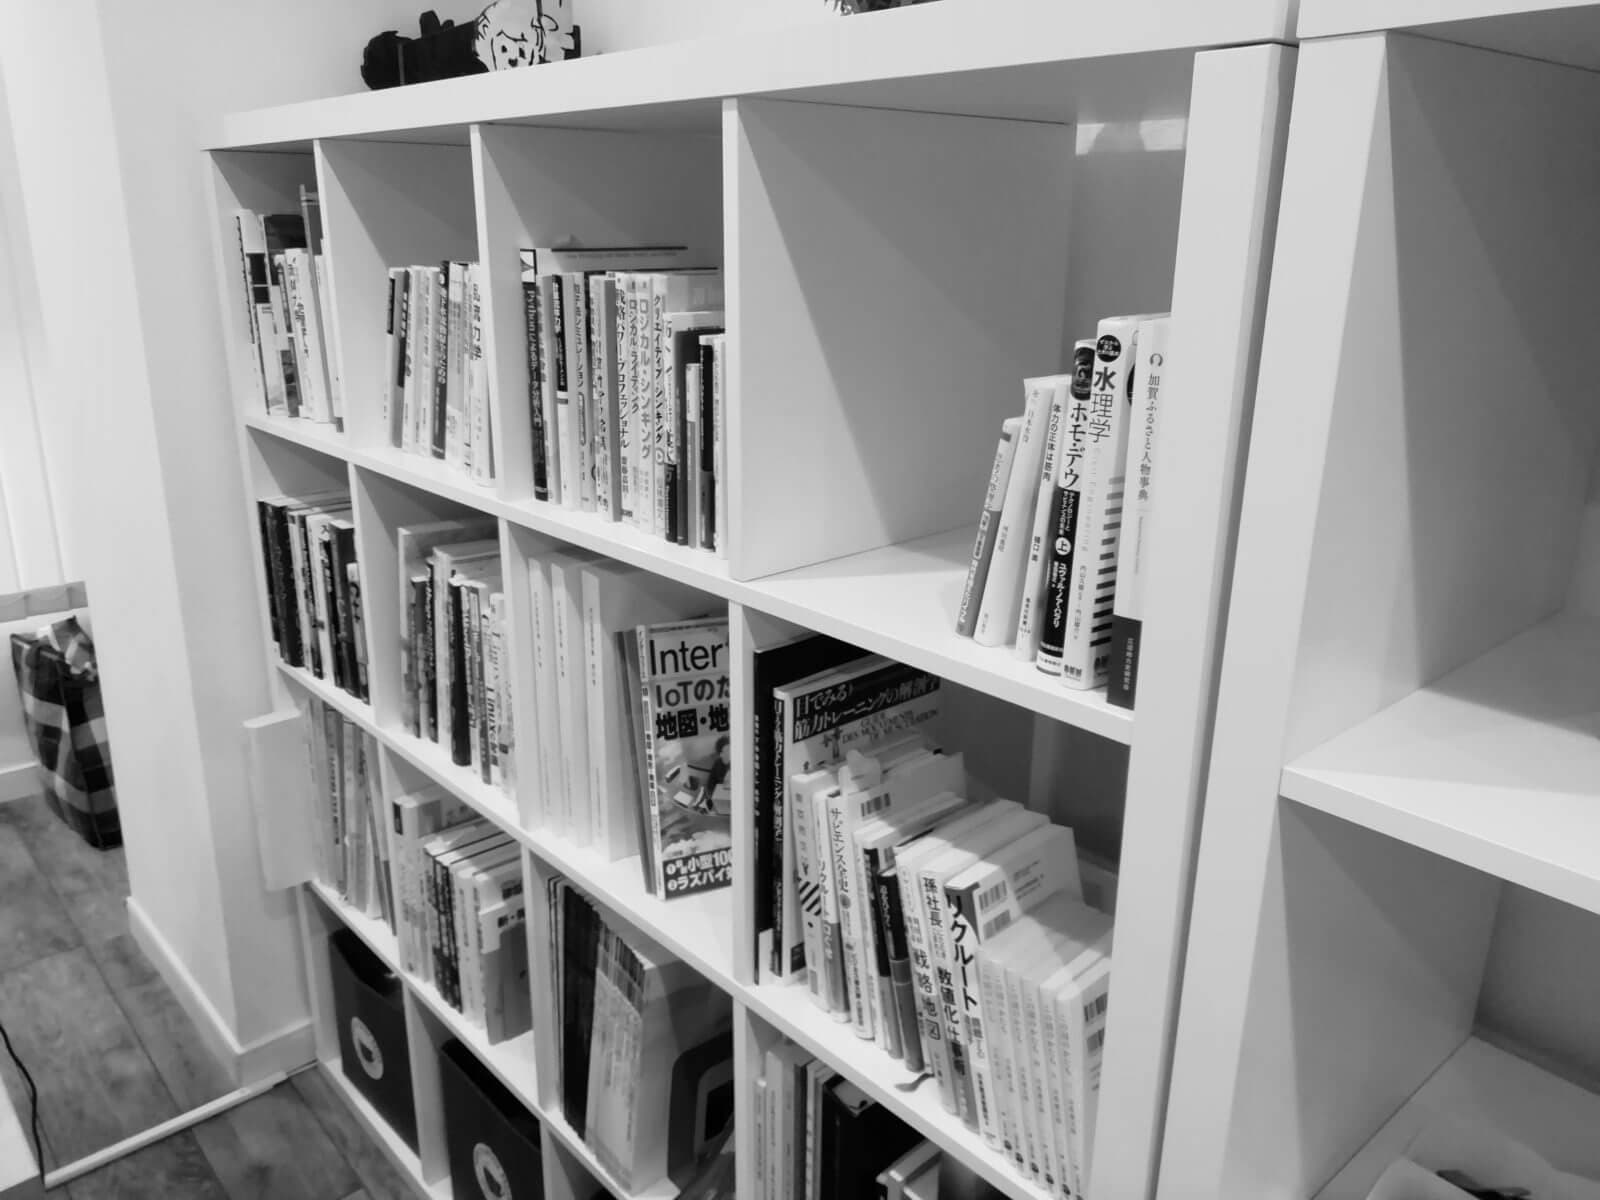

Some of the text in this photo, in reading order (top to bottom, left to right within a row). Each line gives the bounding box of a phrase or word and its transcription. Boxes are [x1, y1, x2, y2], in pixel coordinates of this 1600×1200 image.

[1088, 366, 1116, 443] 水理学
[650, 640, 729, 676] Inter
[947, 893, 978, 1011] リクルート
